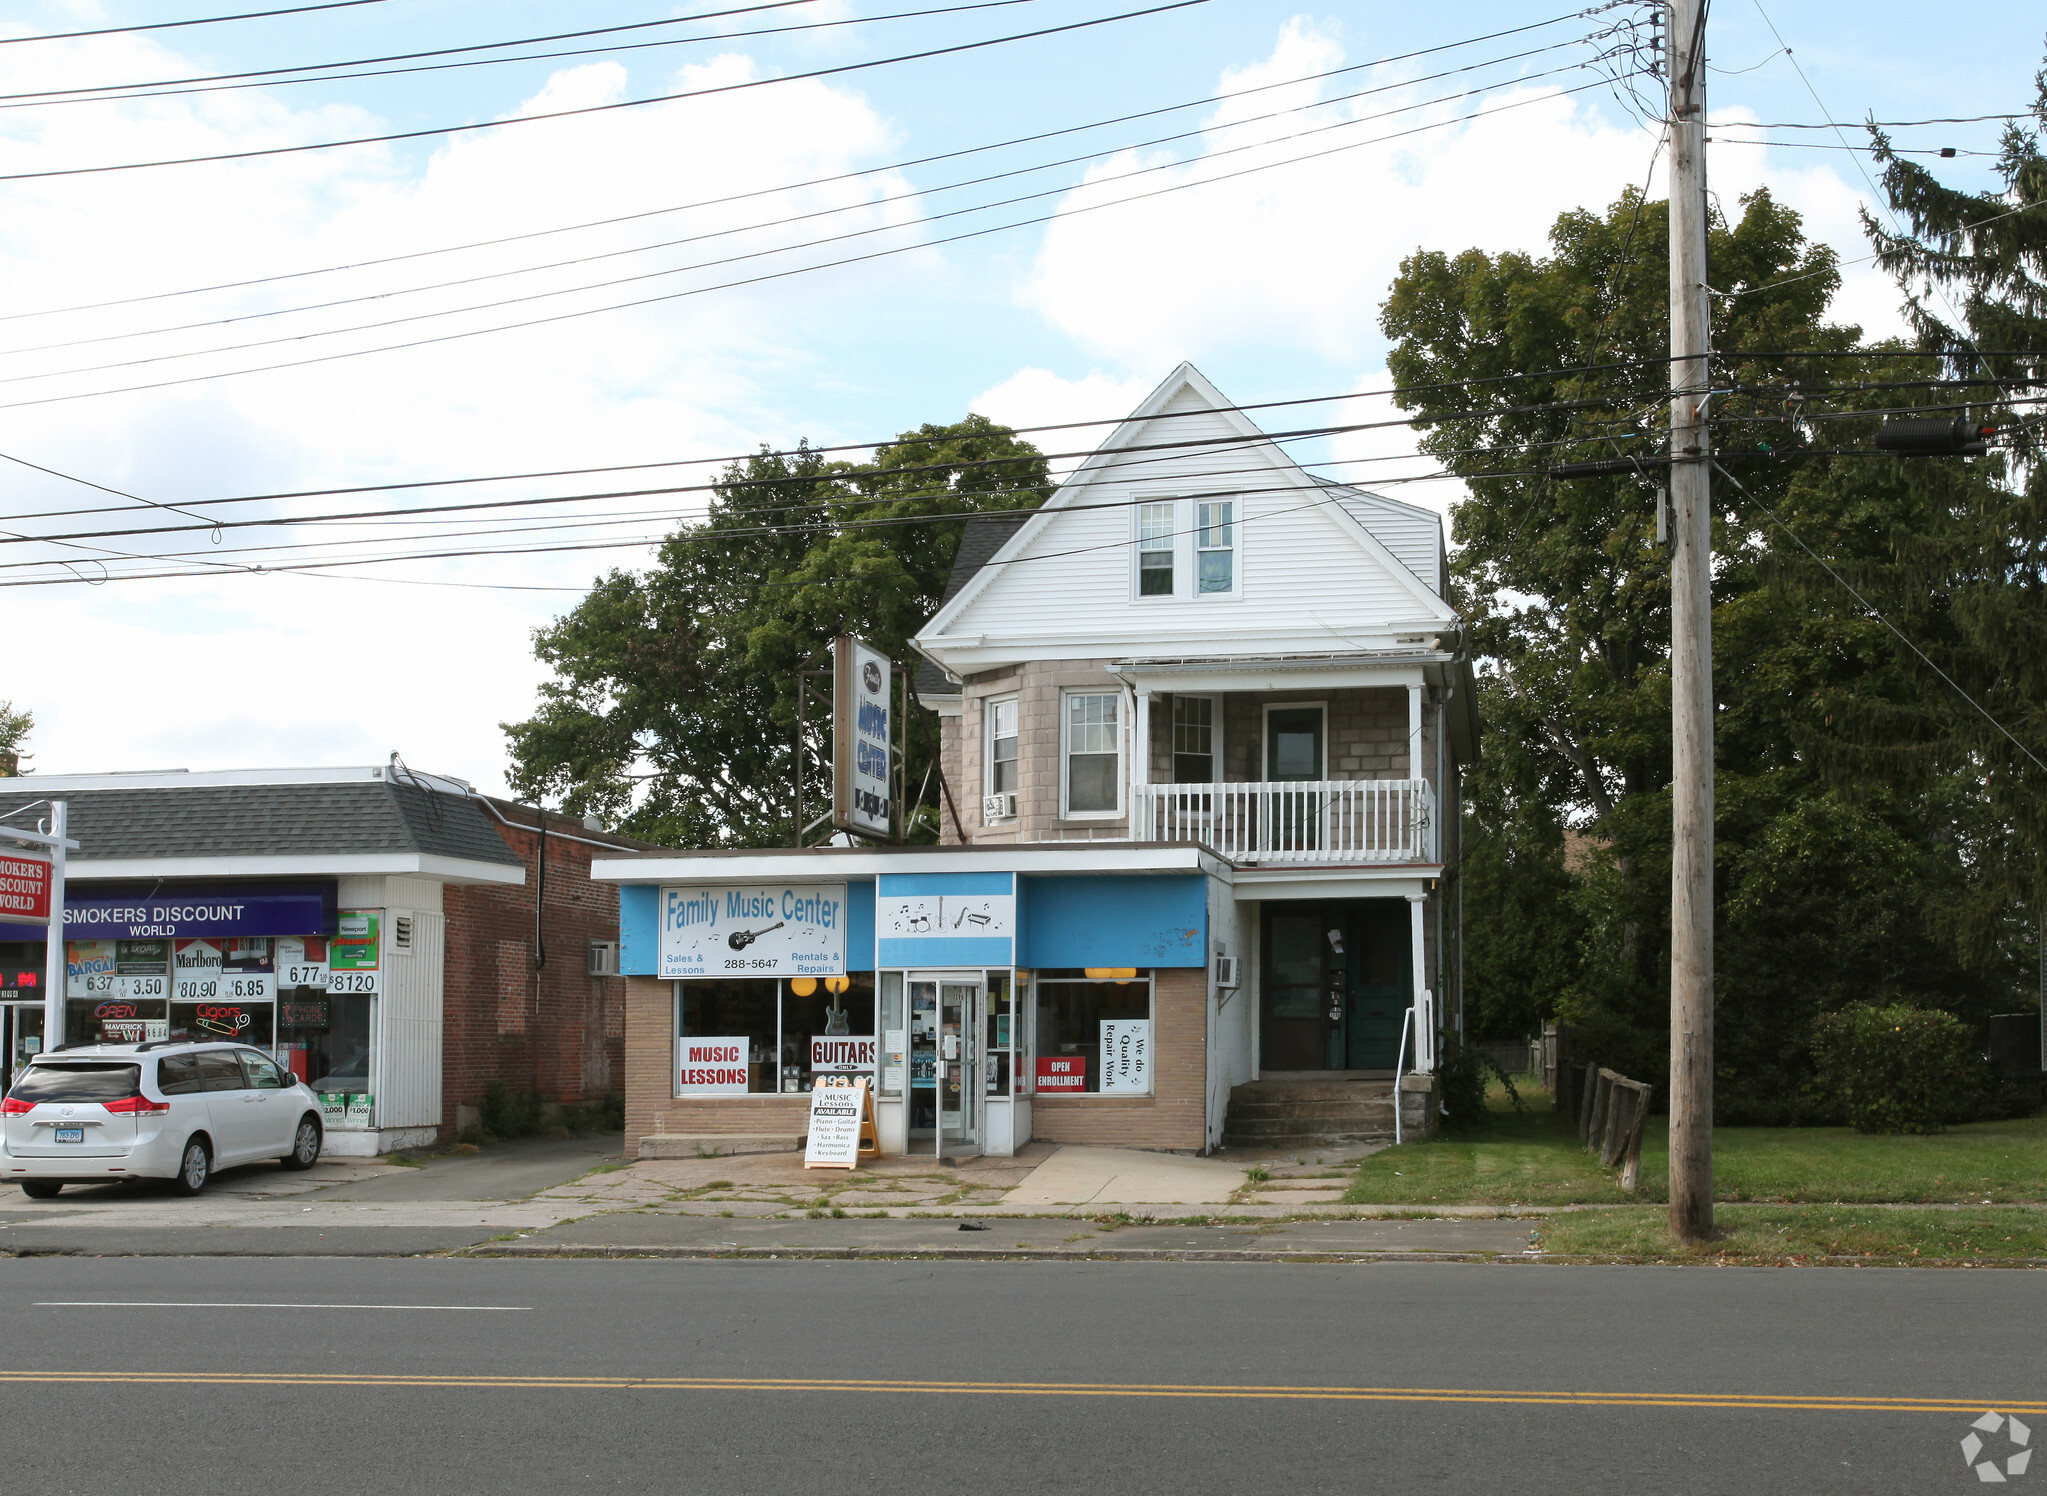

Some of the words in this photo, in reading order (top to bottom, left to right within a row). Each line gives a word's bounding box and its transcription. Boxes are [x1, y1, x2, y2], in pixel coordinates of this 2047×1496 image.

[858, 694, 887, 742] MUSIC
[857, 739, 887, 784] CENTER
[63, 907, 147, 924] SMOKERS
[153, 905, 245, 922] DISCOUNT
[667, 891, 719, 932] Family
[727, 891, 774, 919] Music
[782, 889, 839, 930] Center
[130, 925, 176, 937] WORLD
[341, 926, 367, 934] Newport
[176, 949, 222, 968] Marlboro
[666, 954, 693, 963] Sales
[697, 954, 704, 963] &
[724, 959, 778, 969] 288-5647
[791, 952, 829, 961] Rentals
[832, 952, 840, 961] &
[67, 956, 115, 977] BARGAI
[290, 966, 320, 983] 6.77
[665, 966, 705, 975] Lessons
[797, 964, 834, 975] Repairs
[133, 978, 162, 995] 3.50
[177, 981, 217, 998] $80.90
[231, 980, 264, 997] $6.85
[96, 1005, 138, 1018] OPEN
[196, 1003, 241, 1022] Cigars
[293, 1005, 323, 1014] PHONE
[293, 1013, 323, 1022] CARDS
[1104, 1024, 1116, 1057] Repair
[1135, 1039, 1145, 1055] We
[689, 1047, 739, 1062] MUSIC
[1119, 1035, 1131, 1077] Quality
[1051, 1061, 1071, 1072] OPEN
[1105, 1061, 1115, 1087] Work
[1135, 1060, 1145, 1072] do
[681, 1069, 747, 1085] LESSONS
[1037, 1075, 1084, 1086] ENROLLMENT
